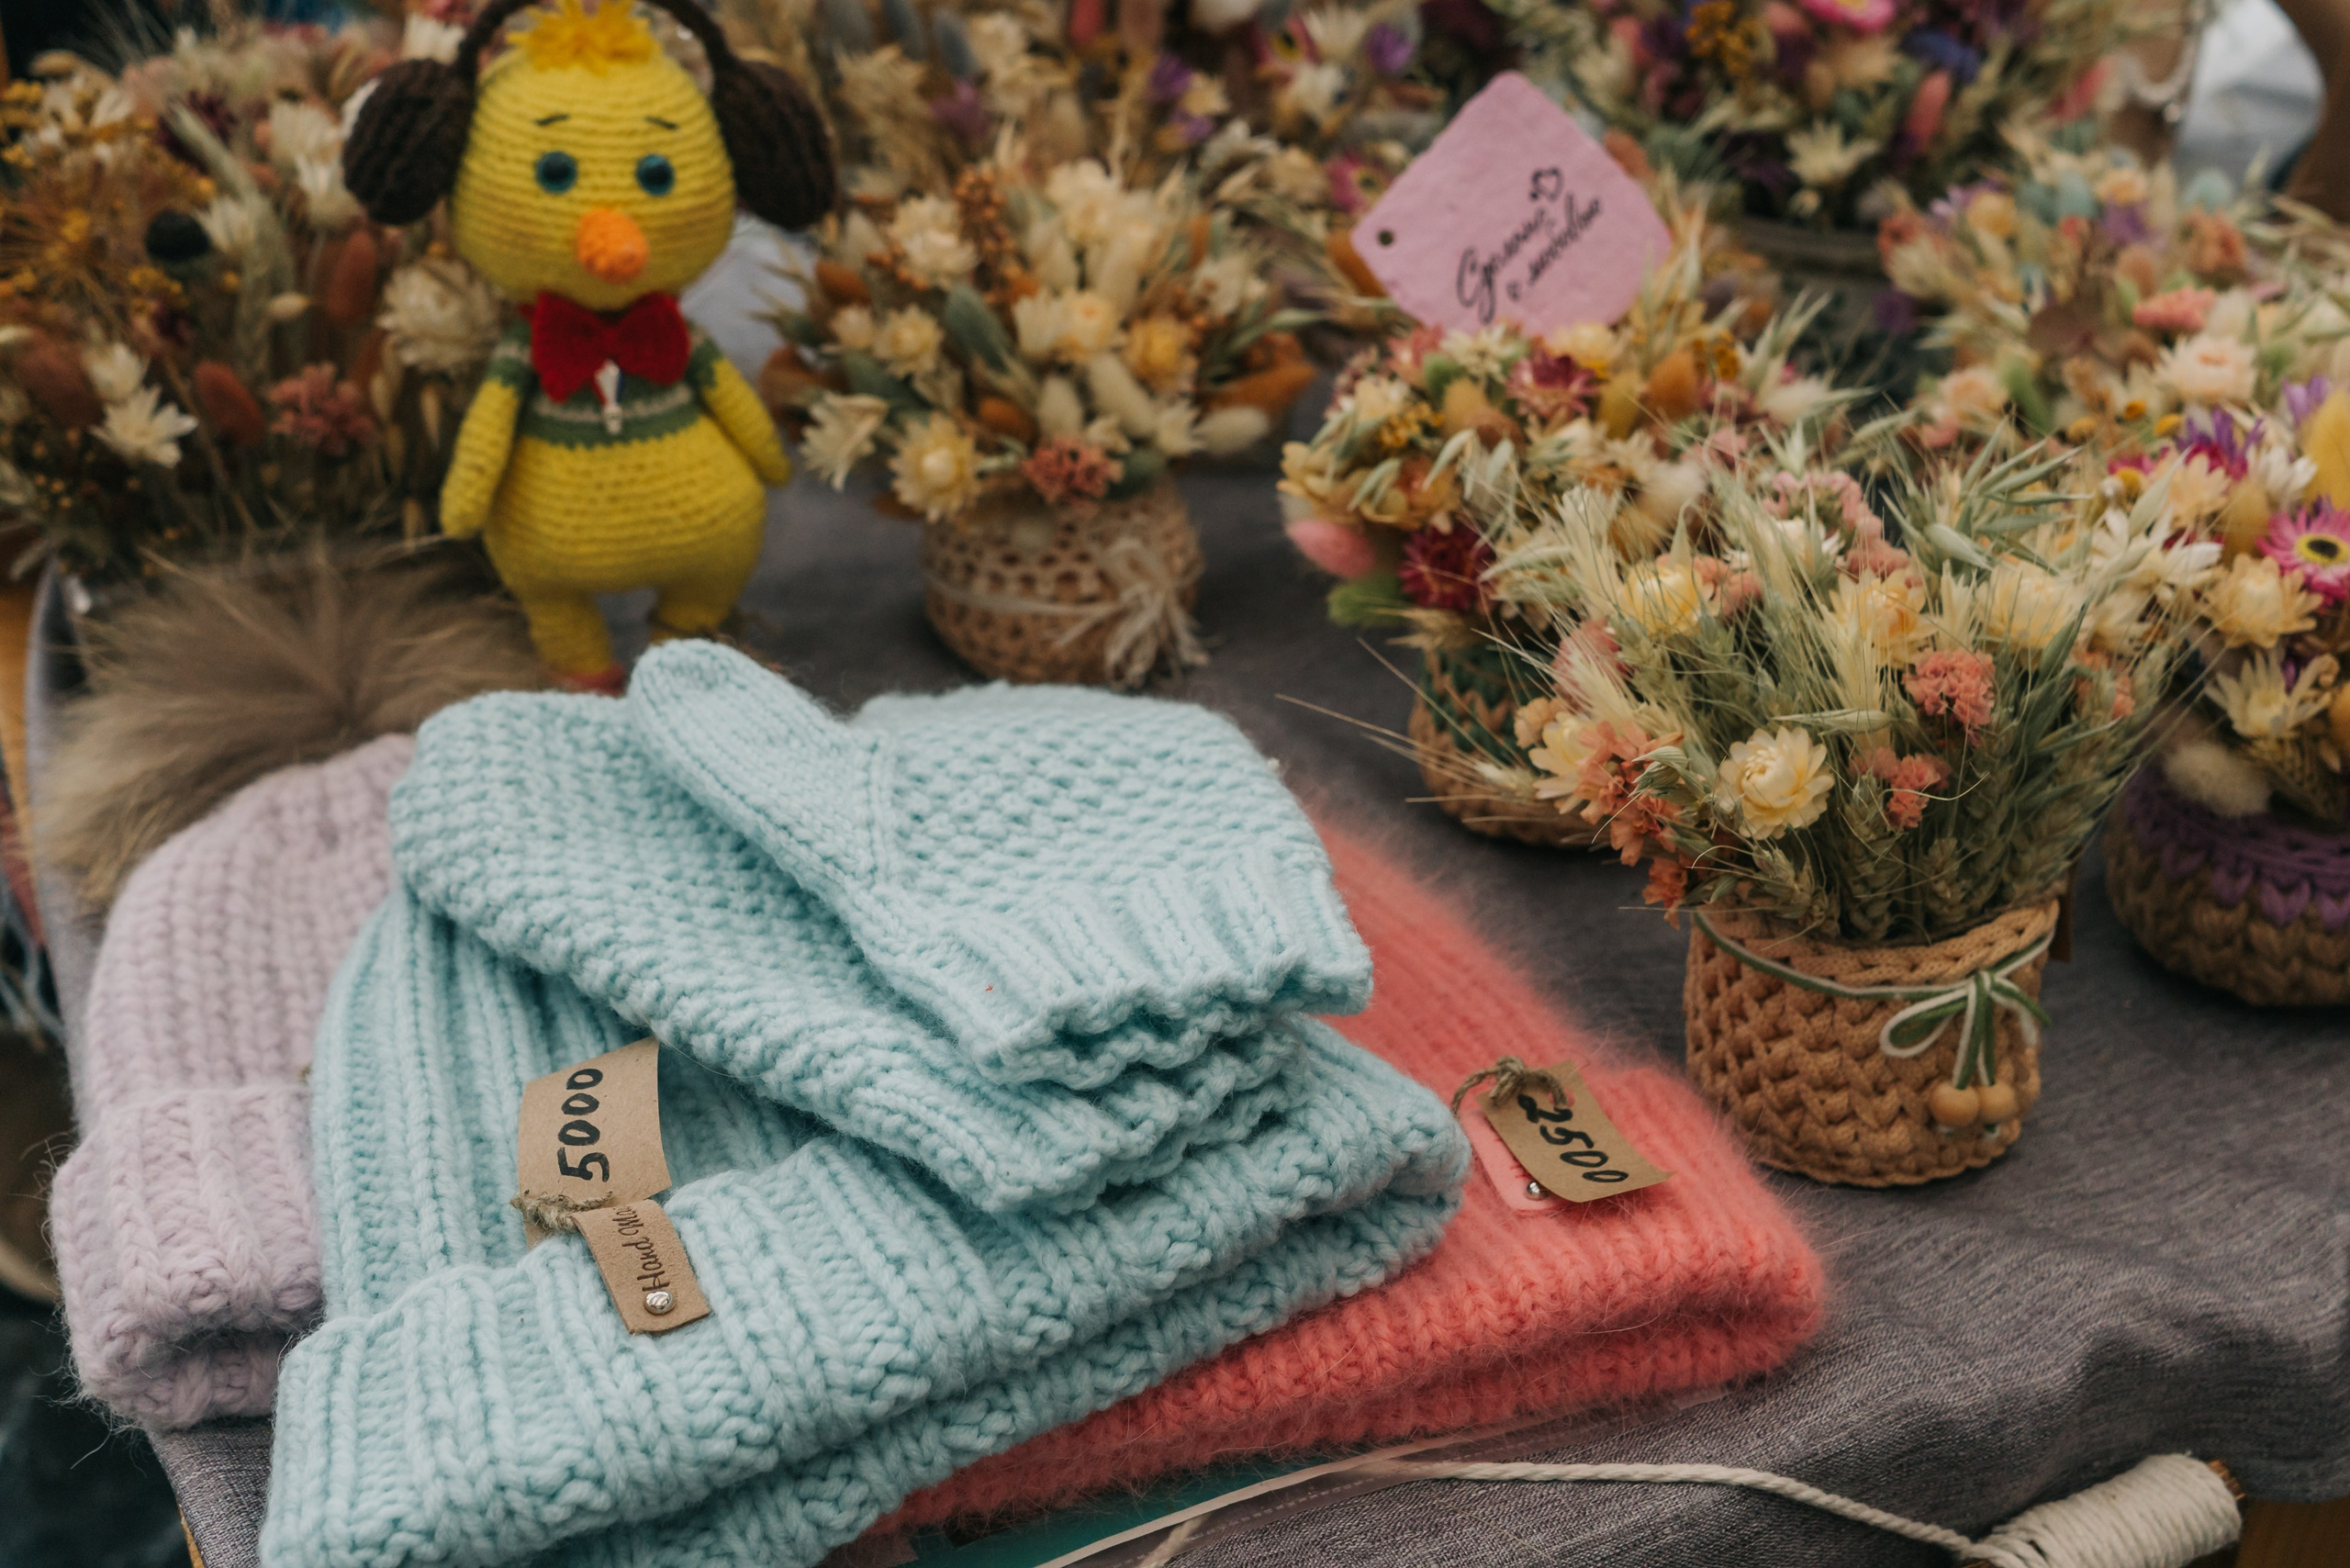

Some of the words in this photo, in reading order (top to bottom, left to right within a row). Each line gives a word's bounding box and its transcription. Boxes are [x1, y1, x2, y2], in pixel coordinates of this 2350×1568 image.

[557, 1068, 610, 1182] 5000
[1517, 1093, 1629, 1183] 2500
[612, 1206, 644, 1237] Ma
[621, 1236, 671, 1292] Hand
